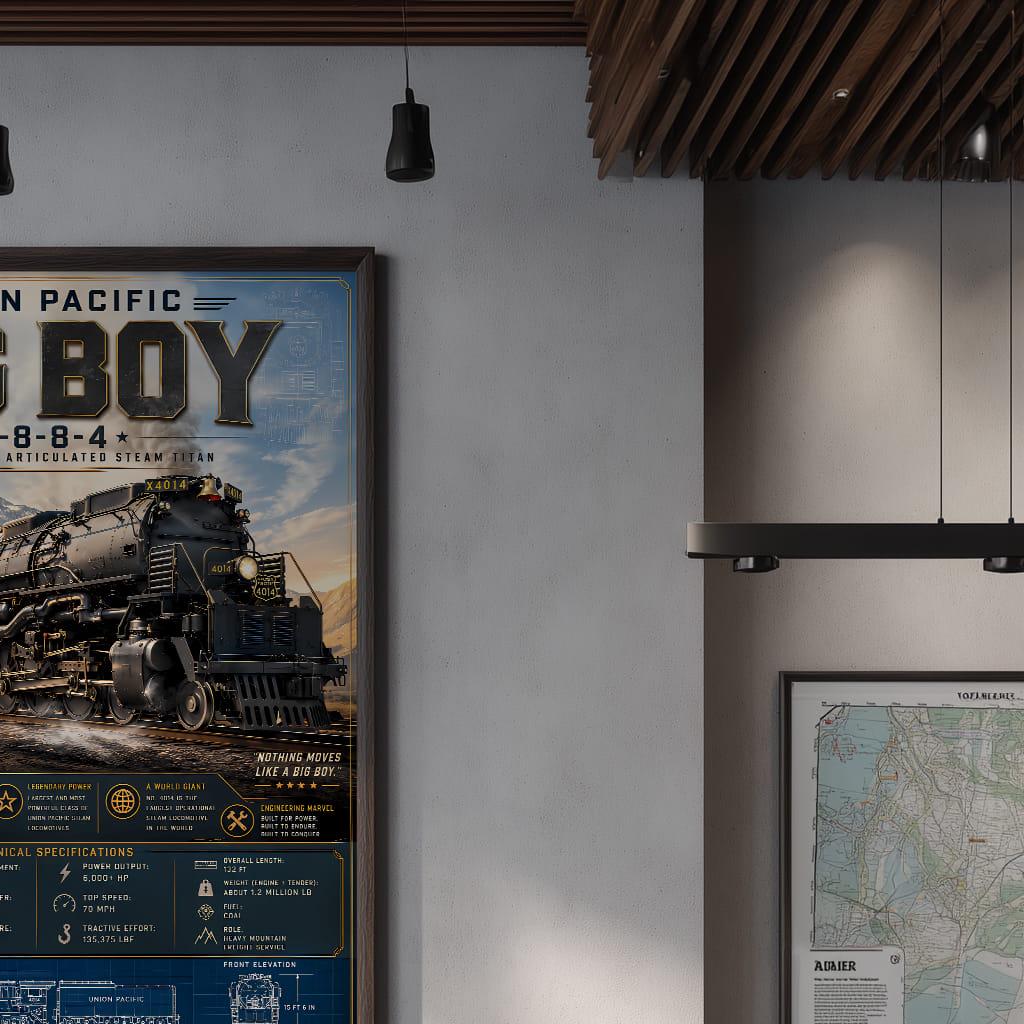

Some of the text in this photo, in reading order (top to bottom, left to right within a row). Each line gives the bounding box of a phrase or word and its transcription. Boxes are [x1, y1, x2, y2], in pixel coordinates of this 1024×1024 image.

[40, 290, 180, 311] PACIFIC
[37, 321, 283, 426] BOY
[6, 452, 106, 462] ARTICULATED
[116, 452, 163, 462] STEAM
[173, 452, 214, 462] TITAN
[147, 479, 186, 491] X4014
[256, 587, 275, 597] 4014
[306, 752, 341, 762] MOVES
[256, 767, 279, 777] LIKE
[282, 767, 289, 777] A
[293, 767, 311, 777] BIG
[260, 804, 335, 812] ENGINEERING MARVEL
[36, 847, 134, 856] SPECIFICATIONS
